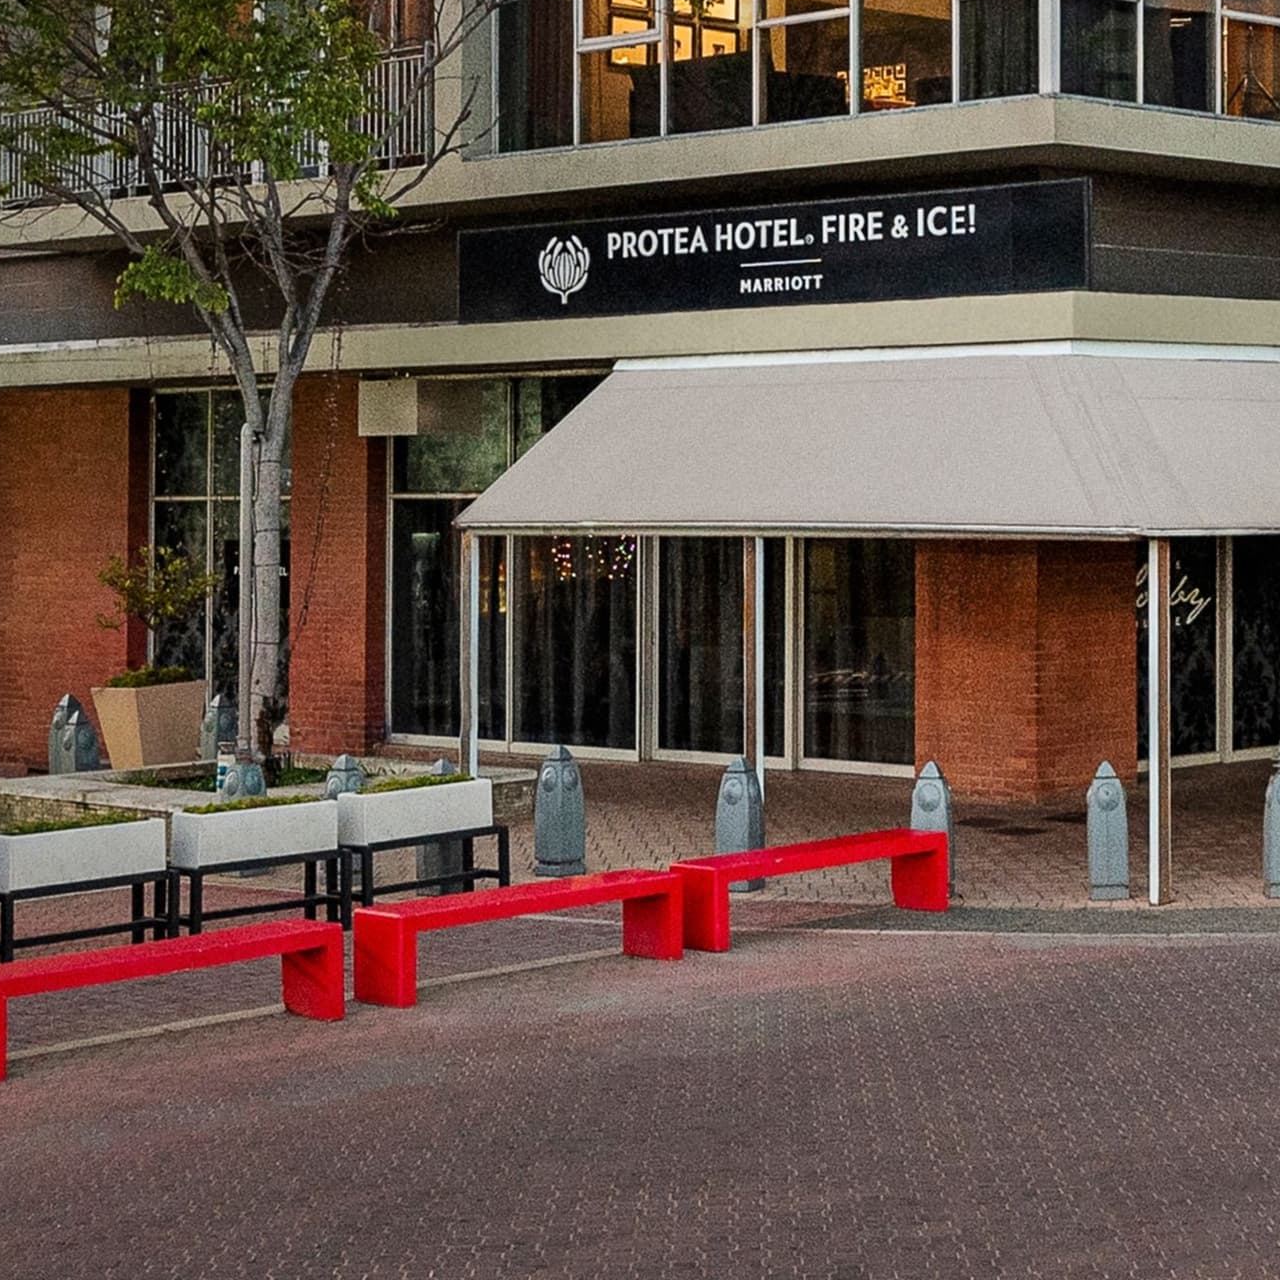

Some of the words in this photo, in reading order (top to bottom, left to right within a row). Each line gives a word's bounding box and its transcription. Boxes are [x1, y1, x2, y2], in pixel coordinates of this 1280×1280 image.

[606, 225, 708, 260] PROTEA
[821, 210, 884, 244] FIRE
[890, 214, 909, 239] &
[916, 203, 976, 237] ICE!
[739, 273, 823, 294] MARRIOTT
